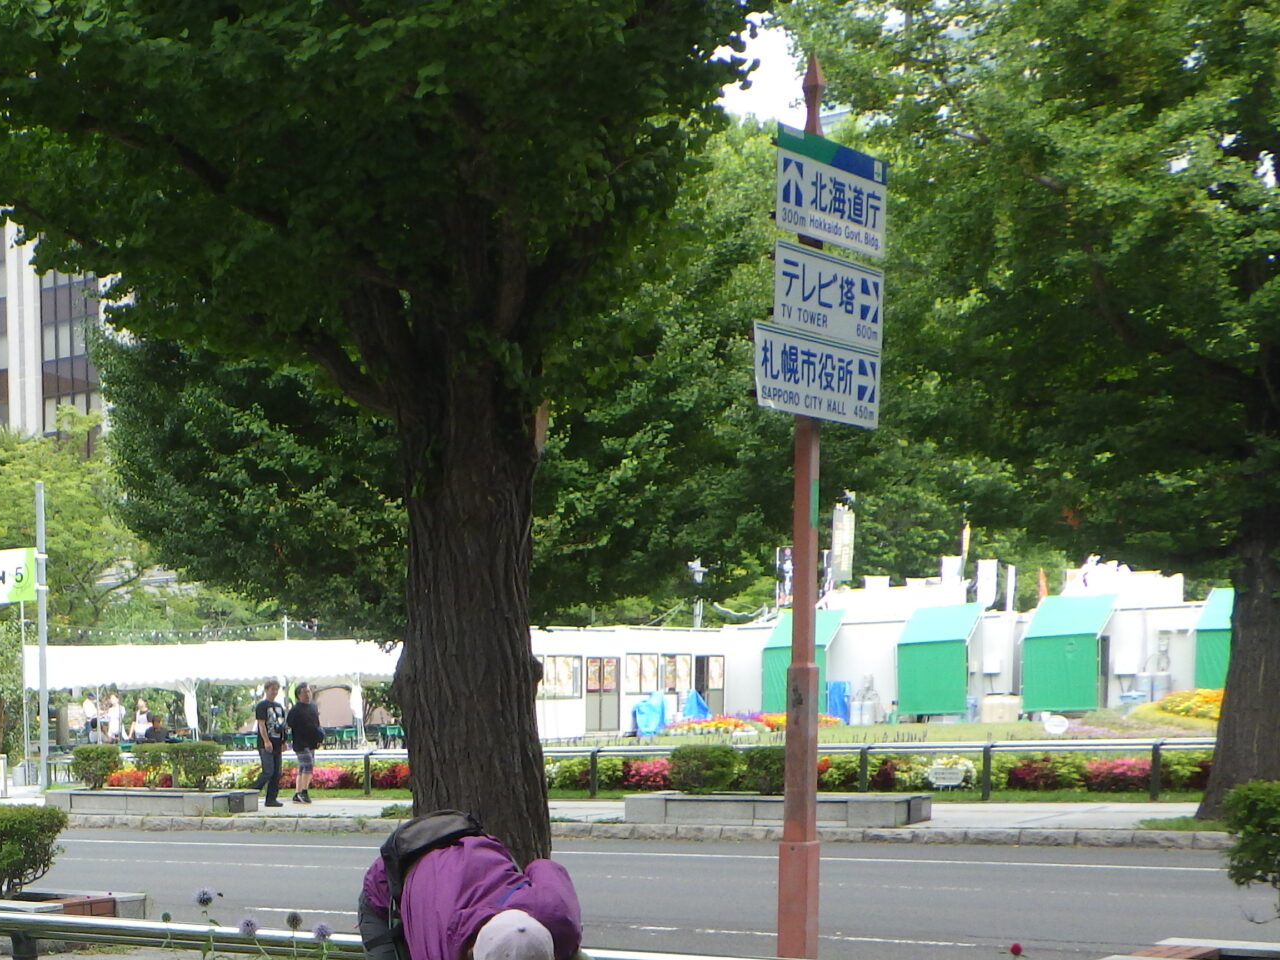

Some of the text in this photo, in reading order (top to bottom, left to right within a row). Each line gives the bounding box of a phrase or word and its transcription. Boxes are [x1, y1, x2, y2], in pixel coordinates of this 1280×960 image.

[811, 171, 882, 229] 北海道庁
[782, 207, 880, 250] 300m Hokkaido Govt. Bldg.
[782, 258, 855, 315] テレビ塔
[781, 303, 828, 328] TV TOWER
[856, 323, 878, 341] 600m
[761, 339, 853, 395] 札幌市役所
[761, 384, 847, 416] SAPPORO CITY HALL
[853, 405, 875, 420] 450m
